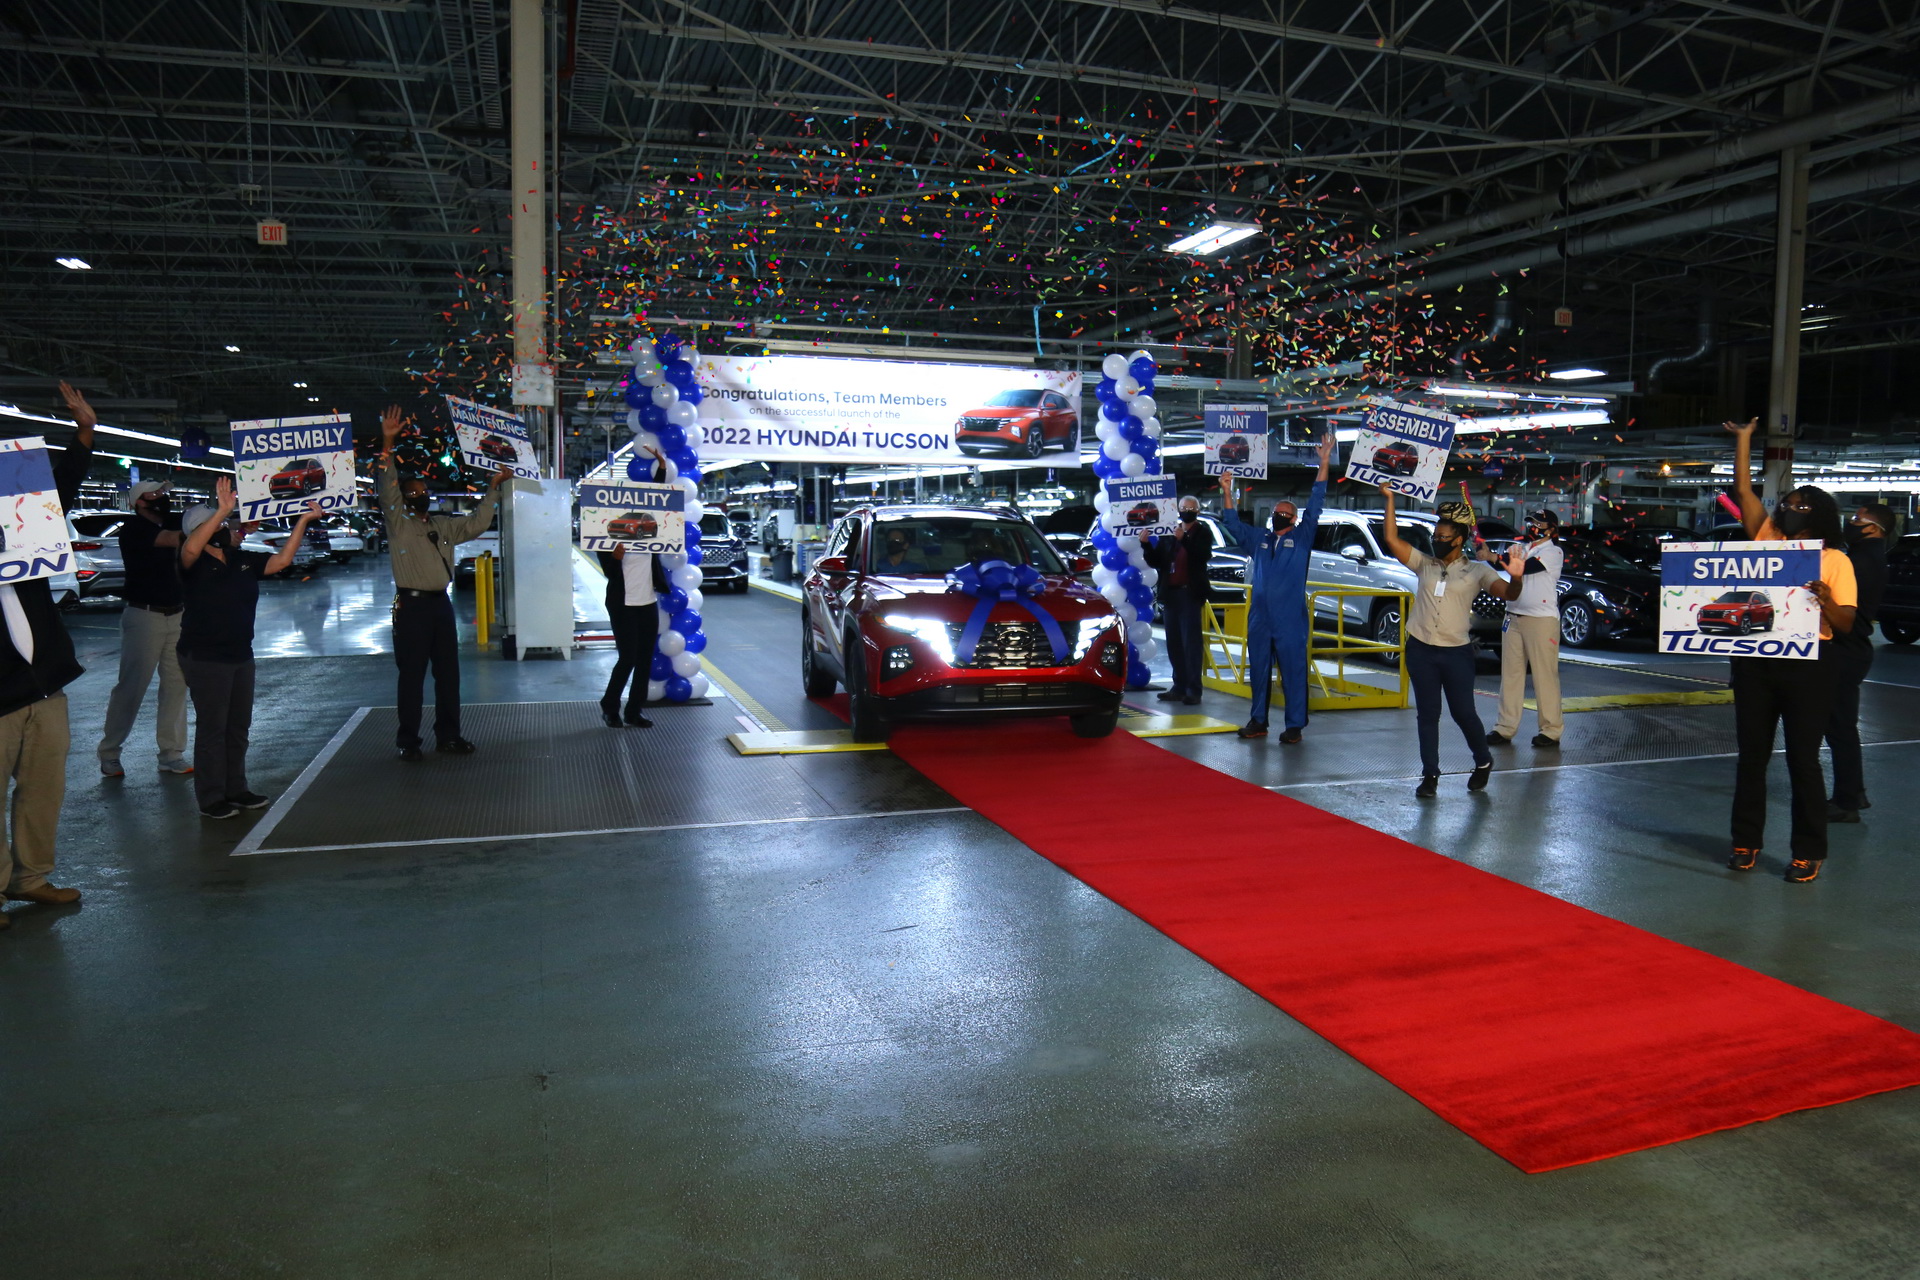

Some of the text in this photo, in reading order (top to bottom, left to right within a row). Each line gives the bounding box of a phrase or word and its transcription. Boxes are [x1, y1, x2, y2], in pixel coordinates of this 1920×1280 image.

[262, 225, 282, 241] EXIT
[701, 386, 947, 407] Congratulations, Team Members
[450, 408, 529, 439] MAINTENANCE
[749, 406, 901, 419] on the successful launch of the
[1220, 414, 1251, 429] PAINT
[1366, 409, 1449, 442] ASSEMBLY
[241, 427, 346, 455] ASSEMBLY
[701, 427, 949, 450] 2022 HYUNDAI TUCSON
[1120, 483, 1163, 498] ENGINE
[1350, 461, 1434, 500] TUCSON
[242, 493, 354, 520] TUCSON
[595, 489, 671, 507] QUALITY
[1692, 557, 1784, 579] STAMP
[1663, 629, 1815, 657] TUCSON
